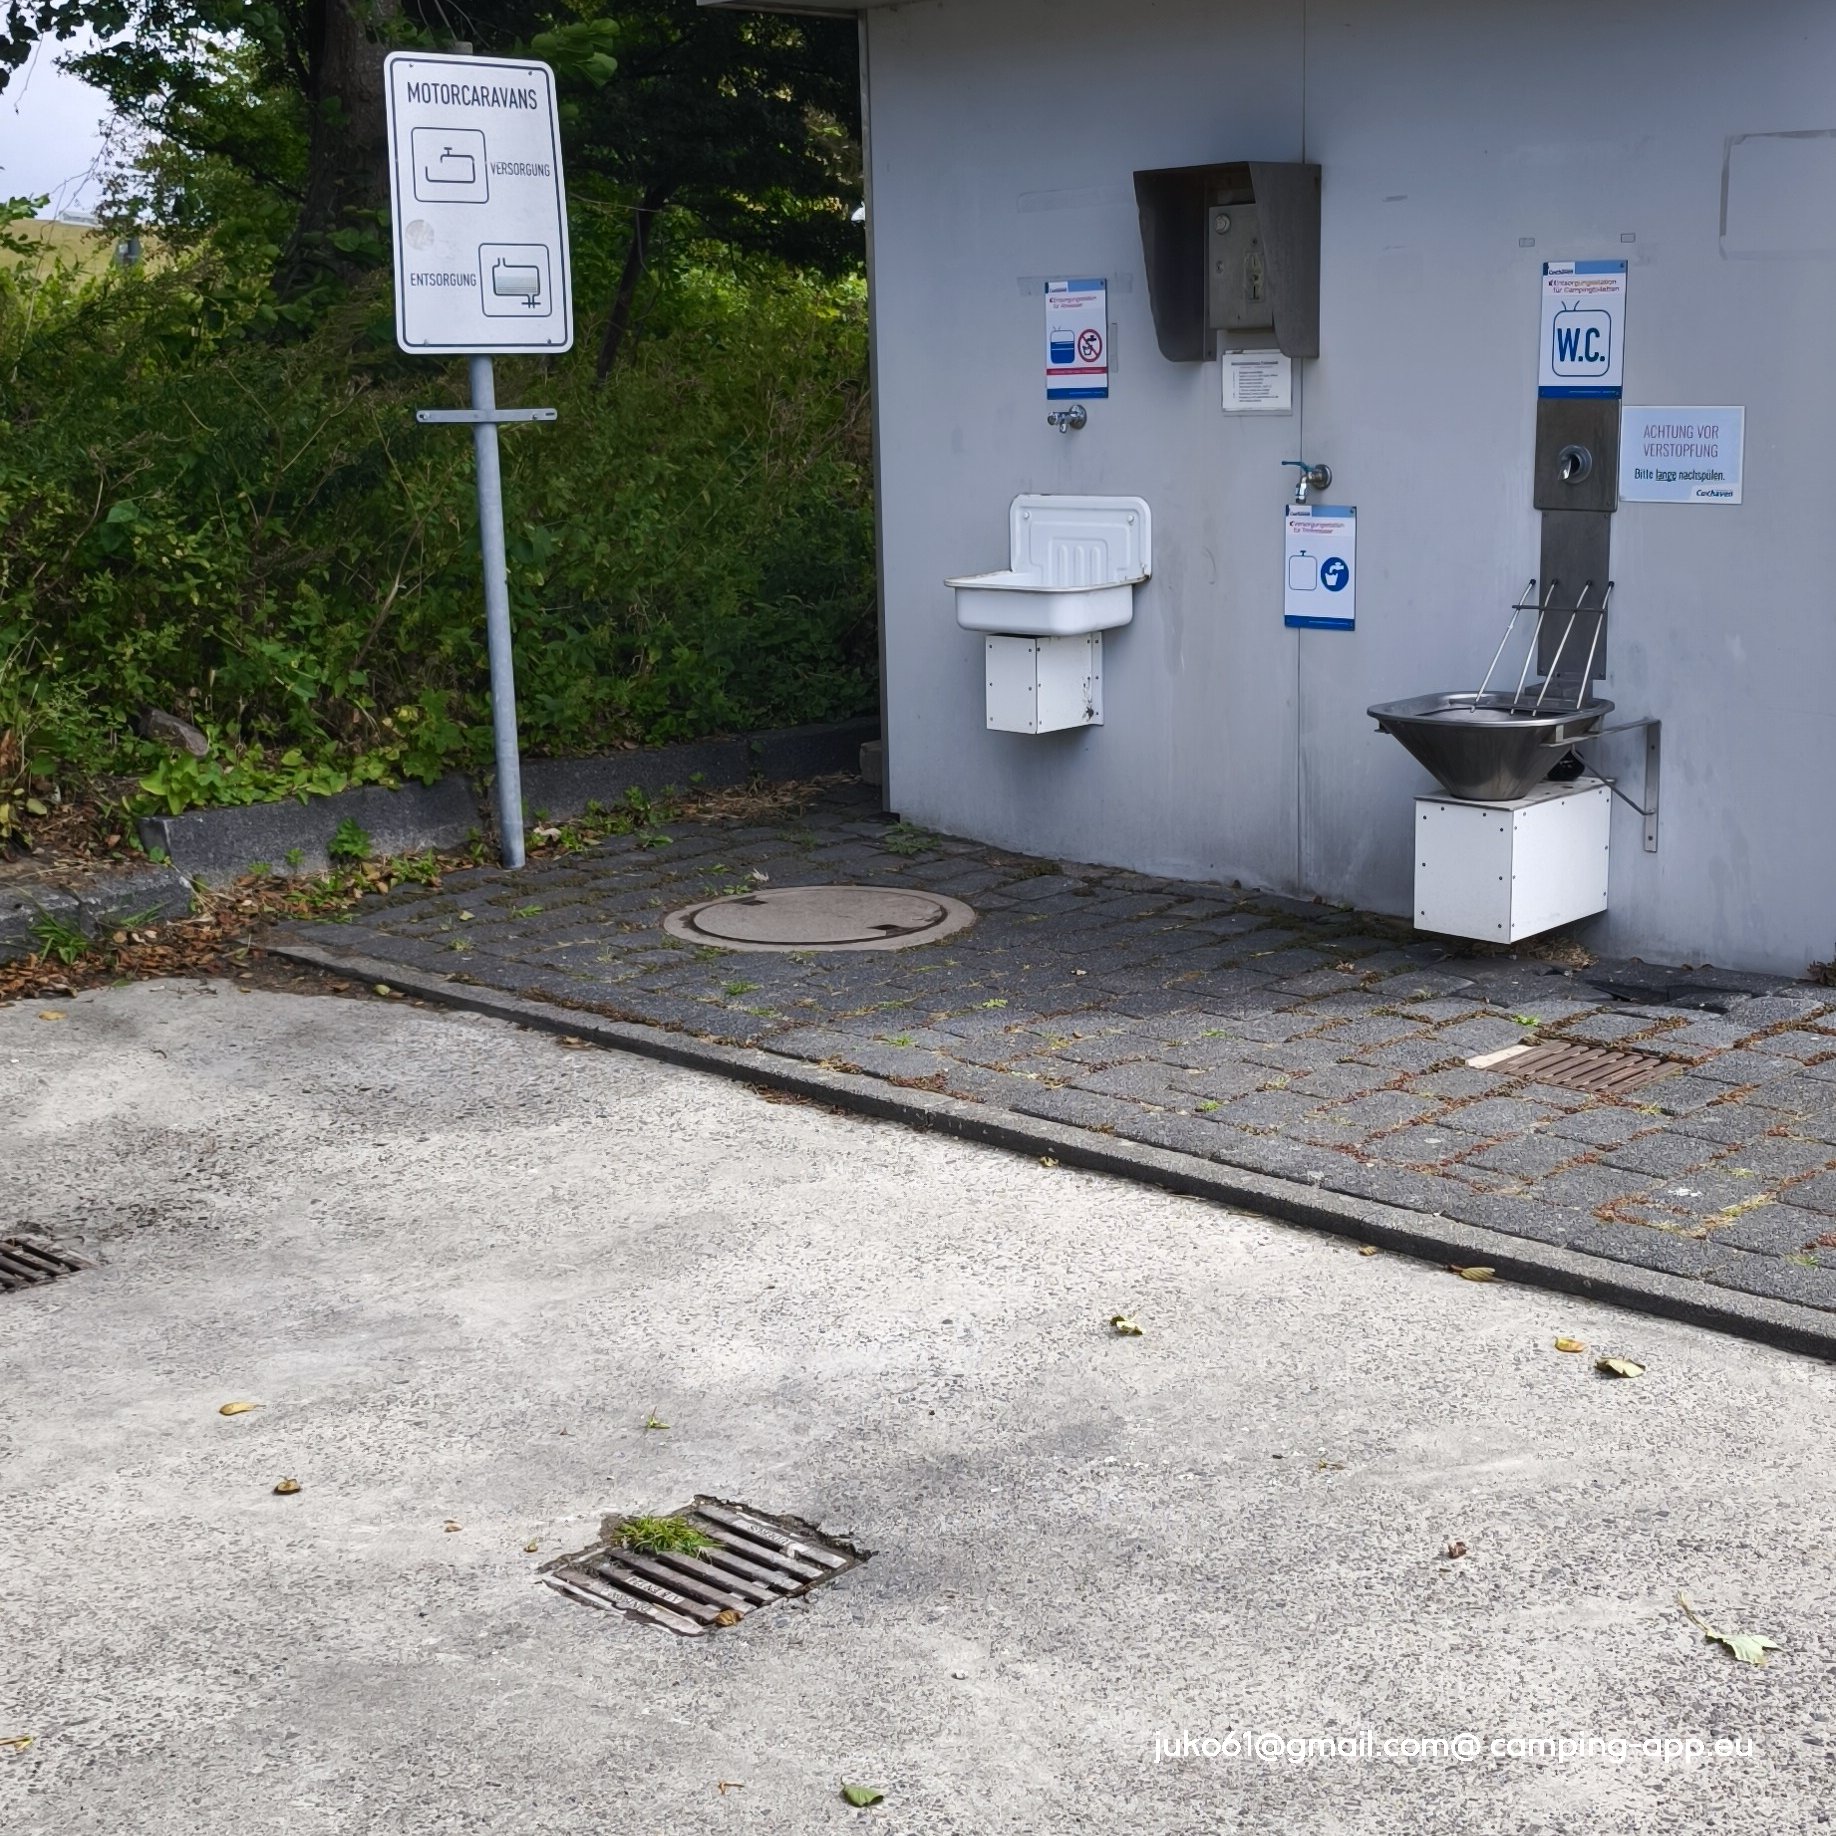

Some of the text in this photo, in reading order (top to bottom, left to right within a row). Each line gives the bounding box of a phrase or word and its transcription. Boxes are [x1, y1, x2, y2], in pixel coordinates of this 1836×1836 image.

[407, 81, 538, 110] MOTORCARAVANS
[490, 162, 550, 177] VERSORGUNG
[410, 272, 477, 287] ENTSORGUNG
[1557, 327, 1606, 362] W.C.
[1643, 424, 1719, 440] ACHTUNG VOR
[1643, 443, 1719, 458] VERSTOPFUNG
[1634, 468, 1726, 482] Bitte lange nachspülen.
